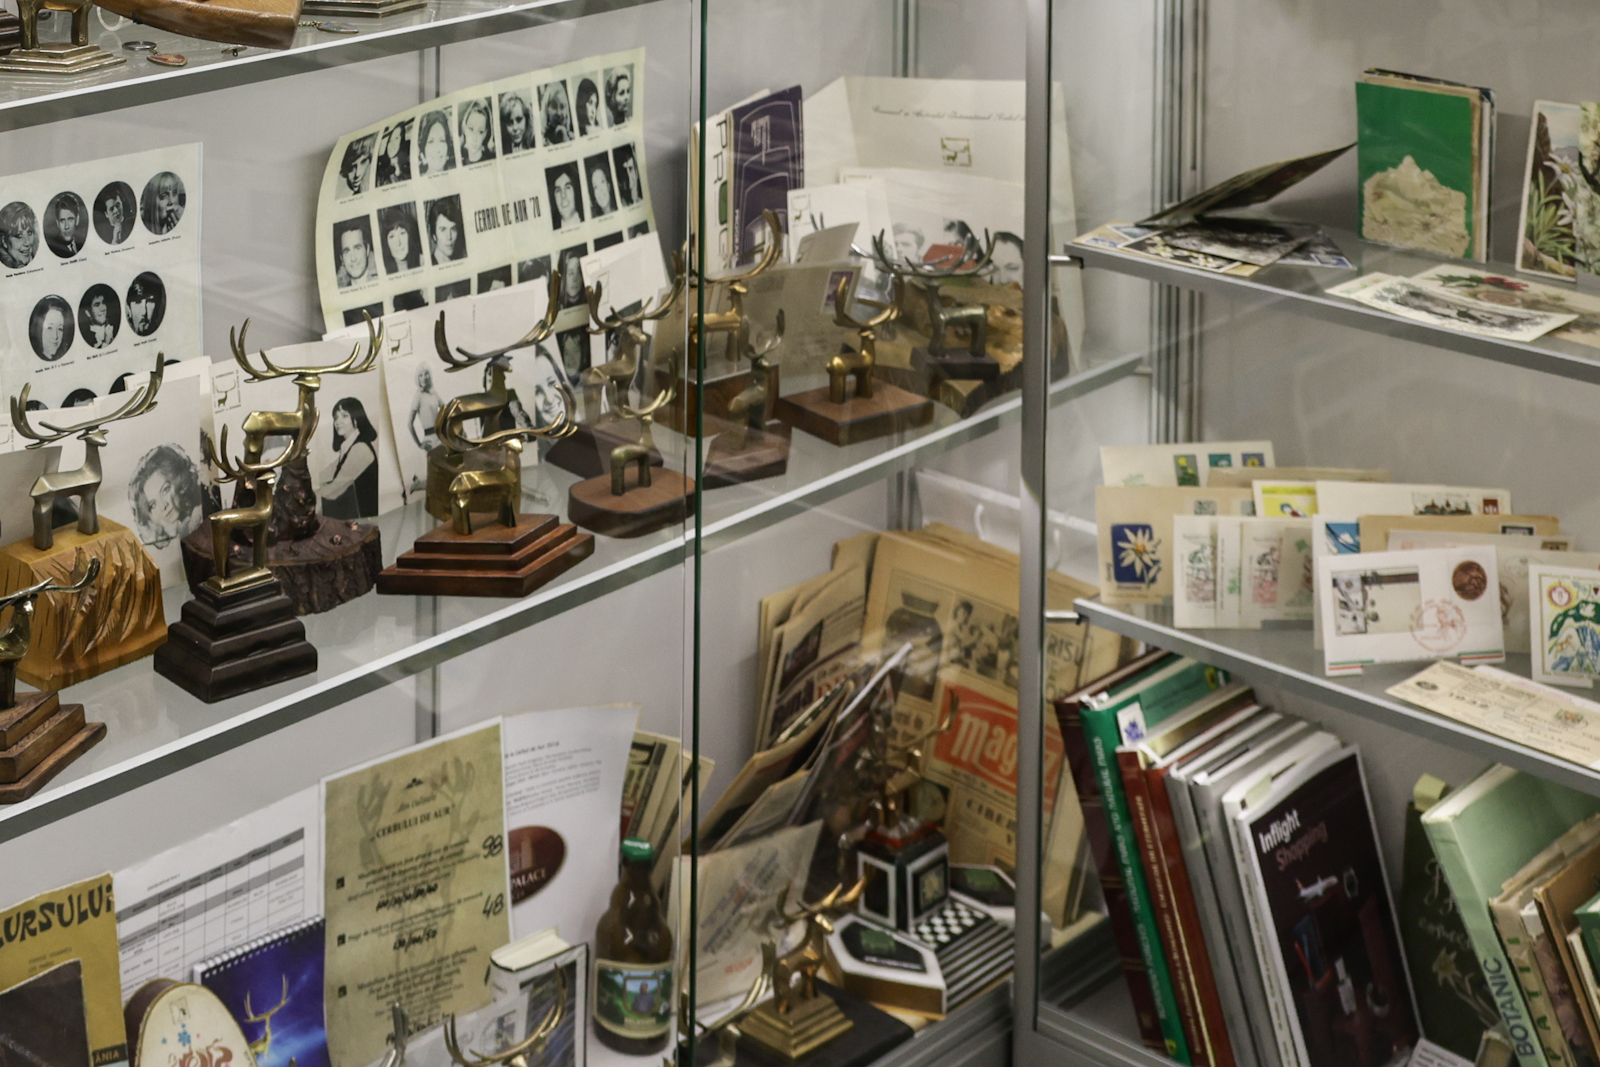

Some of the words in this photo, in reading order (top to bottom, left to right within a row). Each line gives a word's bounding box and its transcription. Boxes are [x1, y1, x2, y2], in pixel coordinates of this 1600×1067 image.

[482, 835, 503, 858] 98
[1259, 808, 1301, 854] Inflight
[483, 894, 504, 919] 48
[1483, 957, 1536, 1056] BOTANIC
